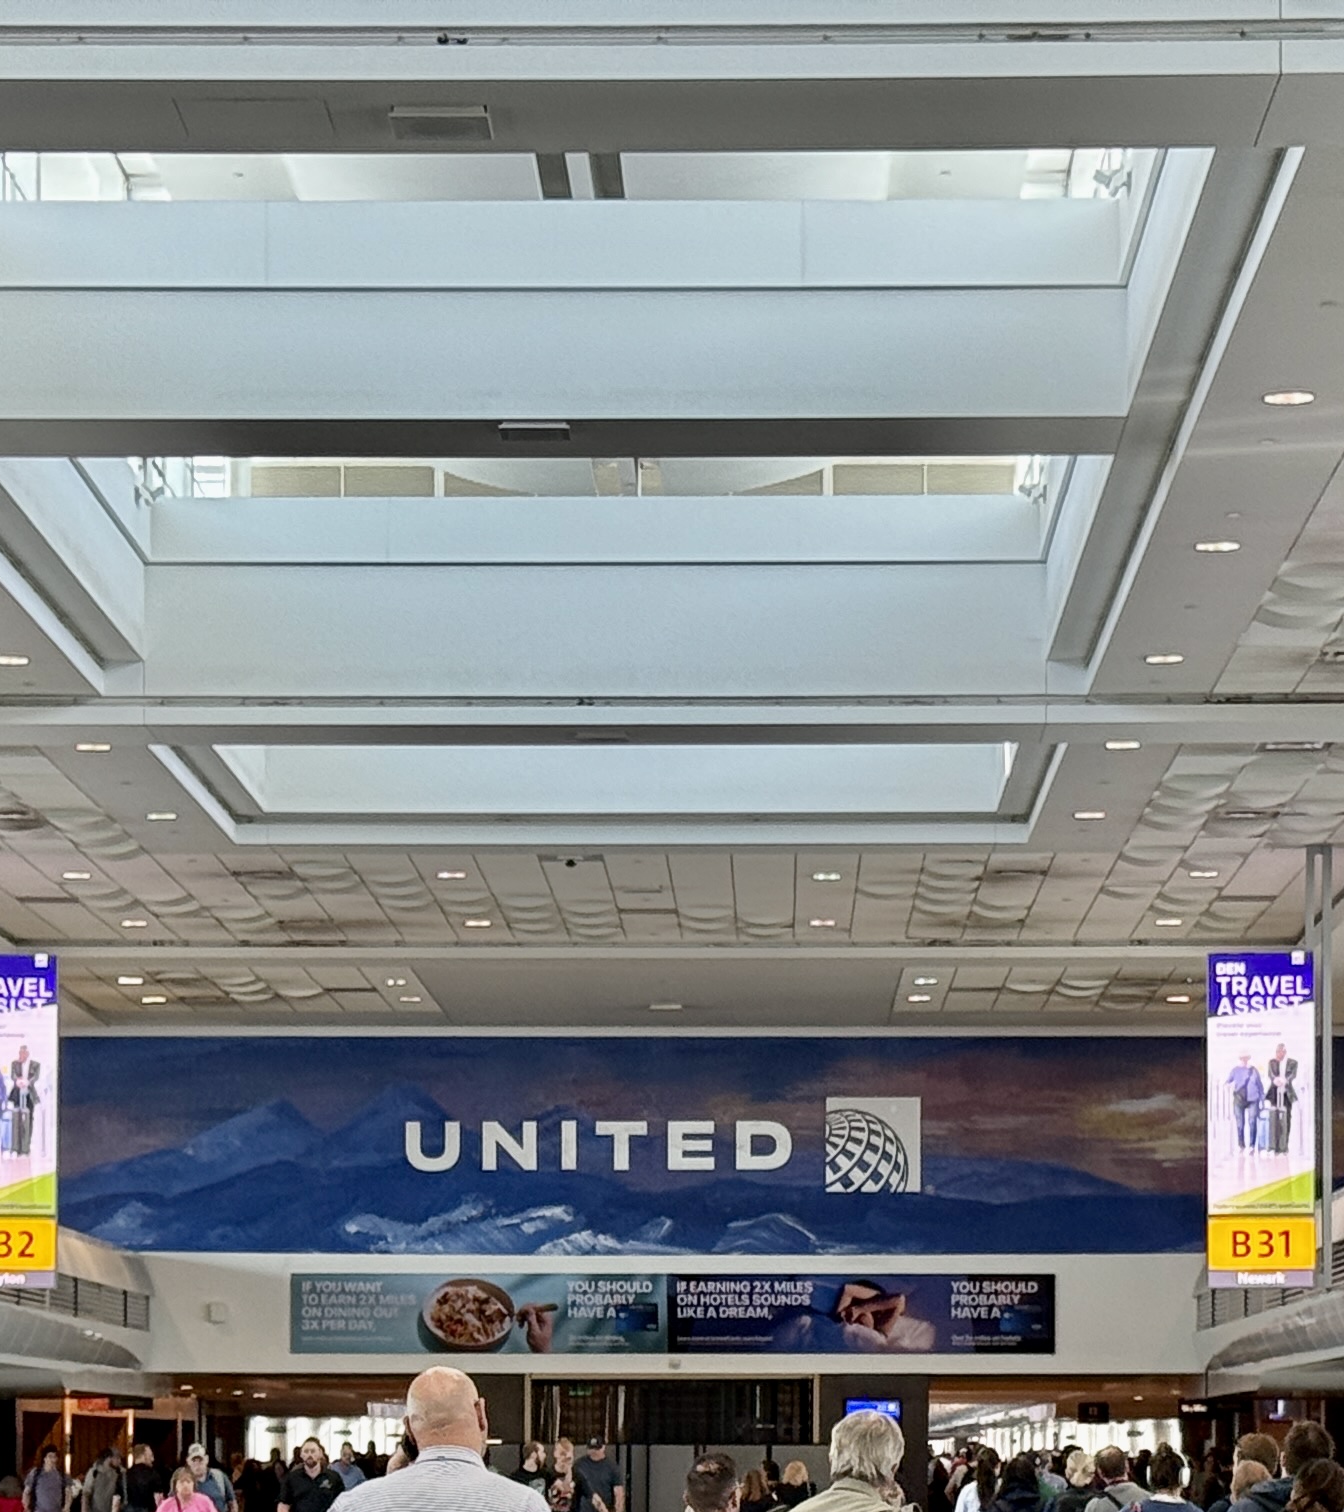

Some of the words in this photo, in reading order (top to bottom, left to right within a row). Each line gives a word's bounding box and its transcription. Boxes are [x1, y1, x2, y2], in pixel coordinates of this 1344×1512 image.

[1216, 962, 1246, 976] DEN
[1216, 975, 1311, 996] TRAVEL
[1217, 996, 1304, 1015] ASSIST
[405, 1120, 793, 1172] UNITED
[1232, 1229, 1290, 1258] B31
[301, 1281, 313, 1292] IF
[315, 1281, 342, 1292] YOU
[343, 1281, 383, 1292] WANT
[567, 1281, 595, 1293] YOU
[597, 1281, 653, 1293] SHOULD
[676, 1281, 687, 1293] IF
[689, 1281, 751, 1293] EARNING
[752, 1281, 771, 1293] 2X
[774, 1281, 813, 1293] MILES
[951, 1281, 980, 1293] YOU
[982, 1281, 1039, 1293] SHOULD
[302, 1294, 319, 1305] TO
[321, 1294, 356, 1305] EARN
[358, 1294, 376, 1305] 2X
[568, 1294, 635, 1305] PROBABLY
[676, 1294, 697, 1306] ON
[699, 1294, 750, 1306] HOTELS
[751, 1294, 811, 1306] SOUNDS
[951, 1294, 1021, 1306] PROBABLY
[301, 1306, 322, 1318] ON
[324, 1306, 371, 1318] DINING
[373, 1306, 399, 1318] OUT
[568, 1306, 604, 1318] HAVE
[606, 1307, 616, 1318] A
[677, 1306, 705, 1318] LIKE
[706, 1306, 717, 1318] A
[719, 1306, 773, 1320] DREAM,
[951, 1306, 989, 1319] HAVE
[990, 1307, 1001, 1319] A
[301, 1319, 320, 1331] 3X
[322, 1319, 346, 1331] PER
